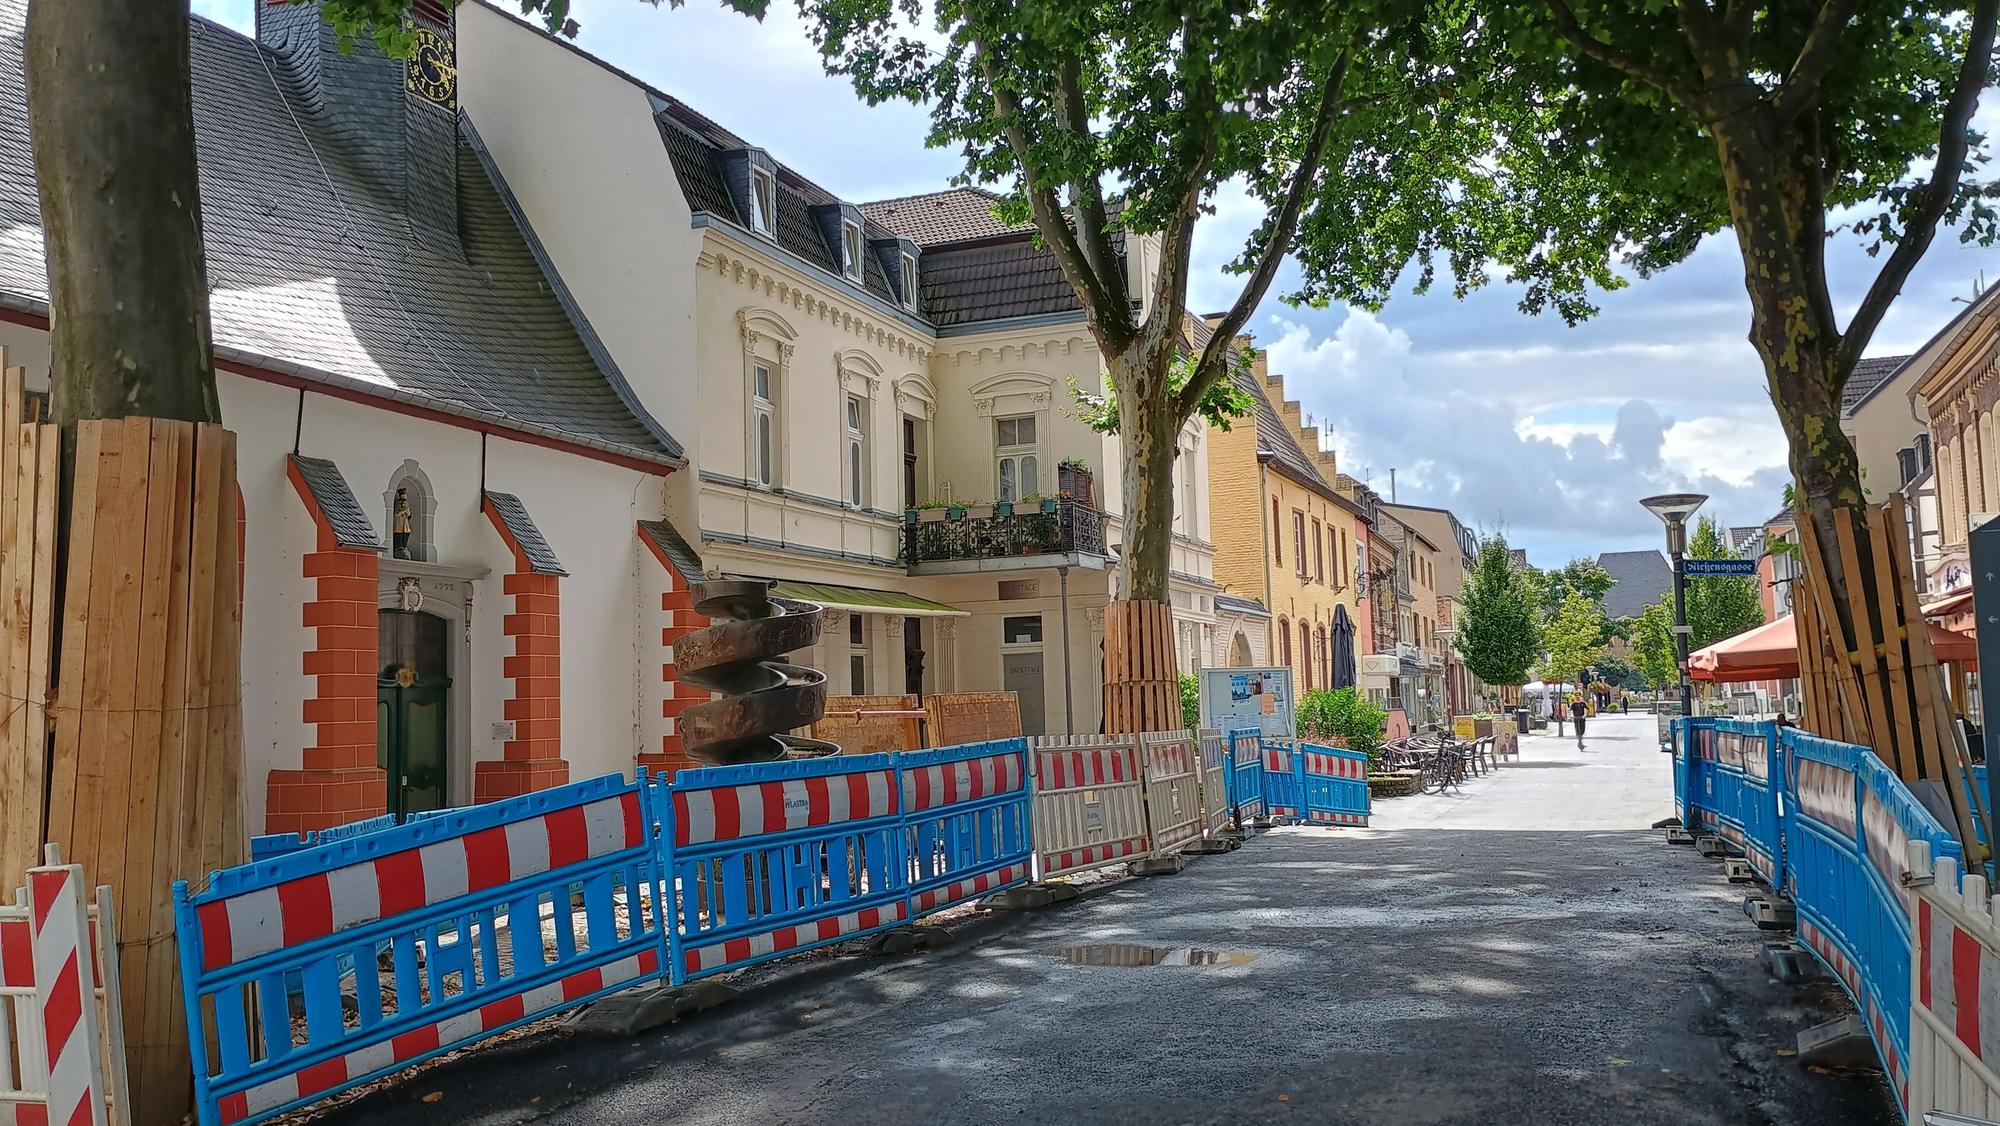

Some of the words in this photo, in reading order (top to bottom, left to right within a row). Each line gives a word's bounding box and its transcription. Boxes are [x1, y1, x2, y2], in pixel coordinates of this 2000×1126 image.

[428, 34, 434, 46] 12
[437, 42, 442, 52] 1
[444, 55, 448, 65] 2
[413, 65, 419, 76] 8
[421, 79, 426, 88] 7
[429, 86, 435, 97] 6
[439, 87, 443, 97] 5
[1010, 583, 1038, 592] STAGE
